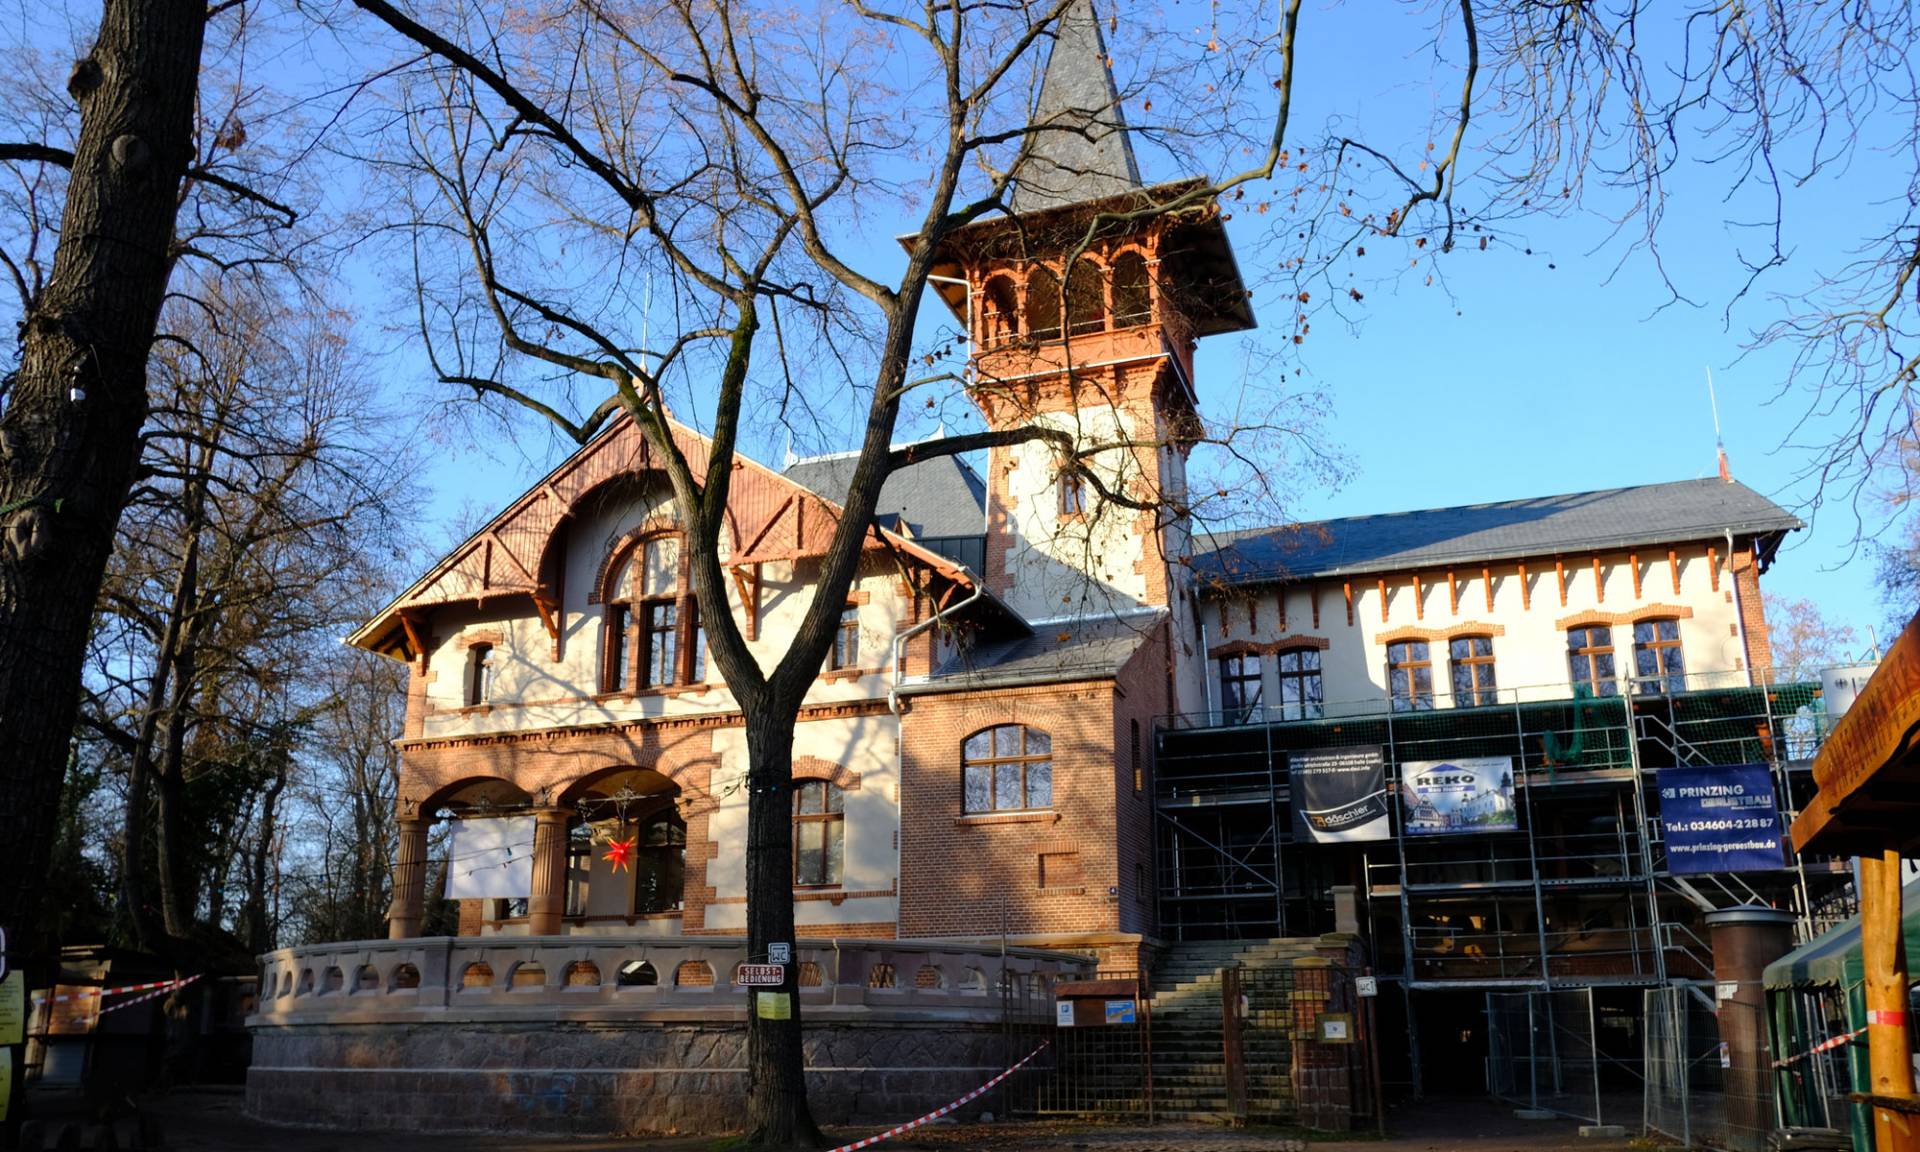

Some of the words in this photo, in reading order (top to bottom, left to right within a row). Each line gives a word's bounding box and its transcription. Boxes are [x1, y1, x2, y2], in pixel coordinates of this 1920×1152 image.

[1417, 775, 1475, 786] REKO
[1679, 785, 1744, 798] PRINZING
[1666, 822, 1689, 832] Tel.:
[1670, 840, 1776, 853] www.prinzing-geruestbau.de
[773, 952, 787, 962] WC
[744, 967, 781, 976] SELBST-
[740, 974, 781, 983] BEDIENUNG
